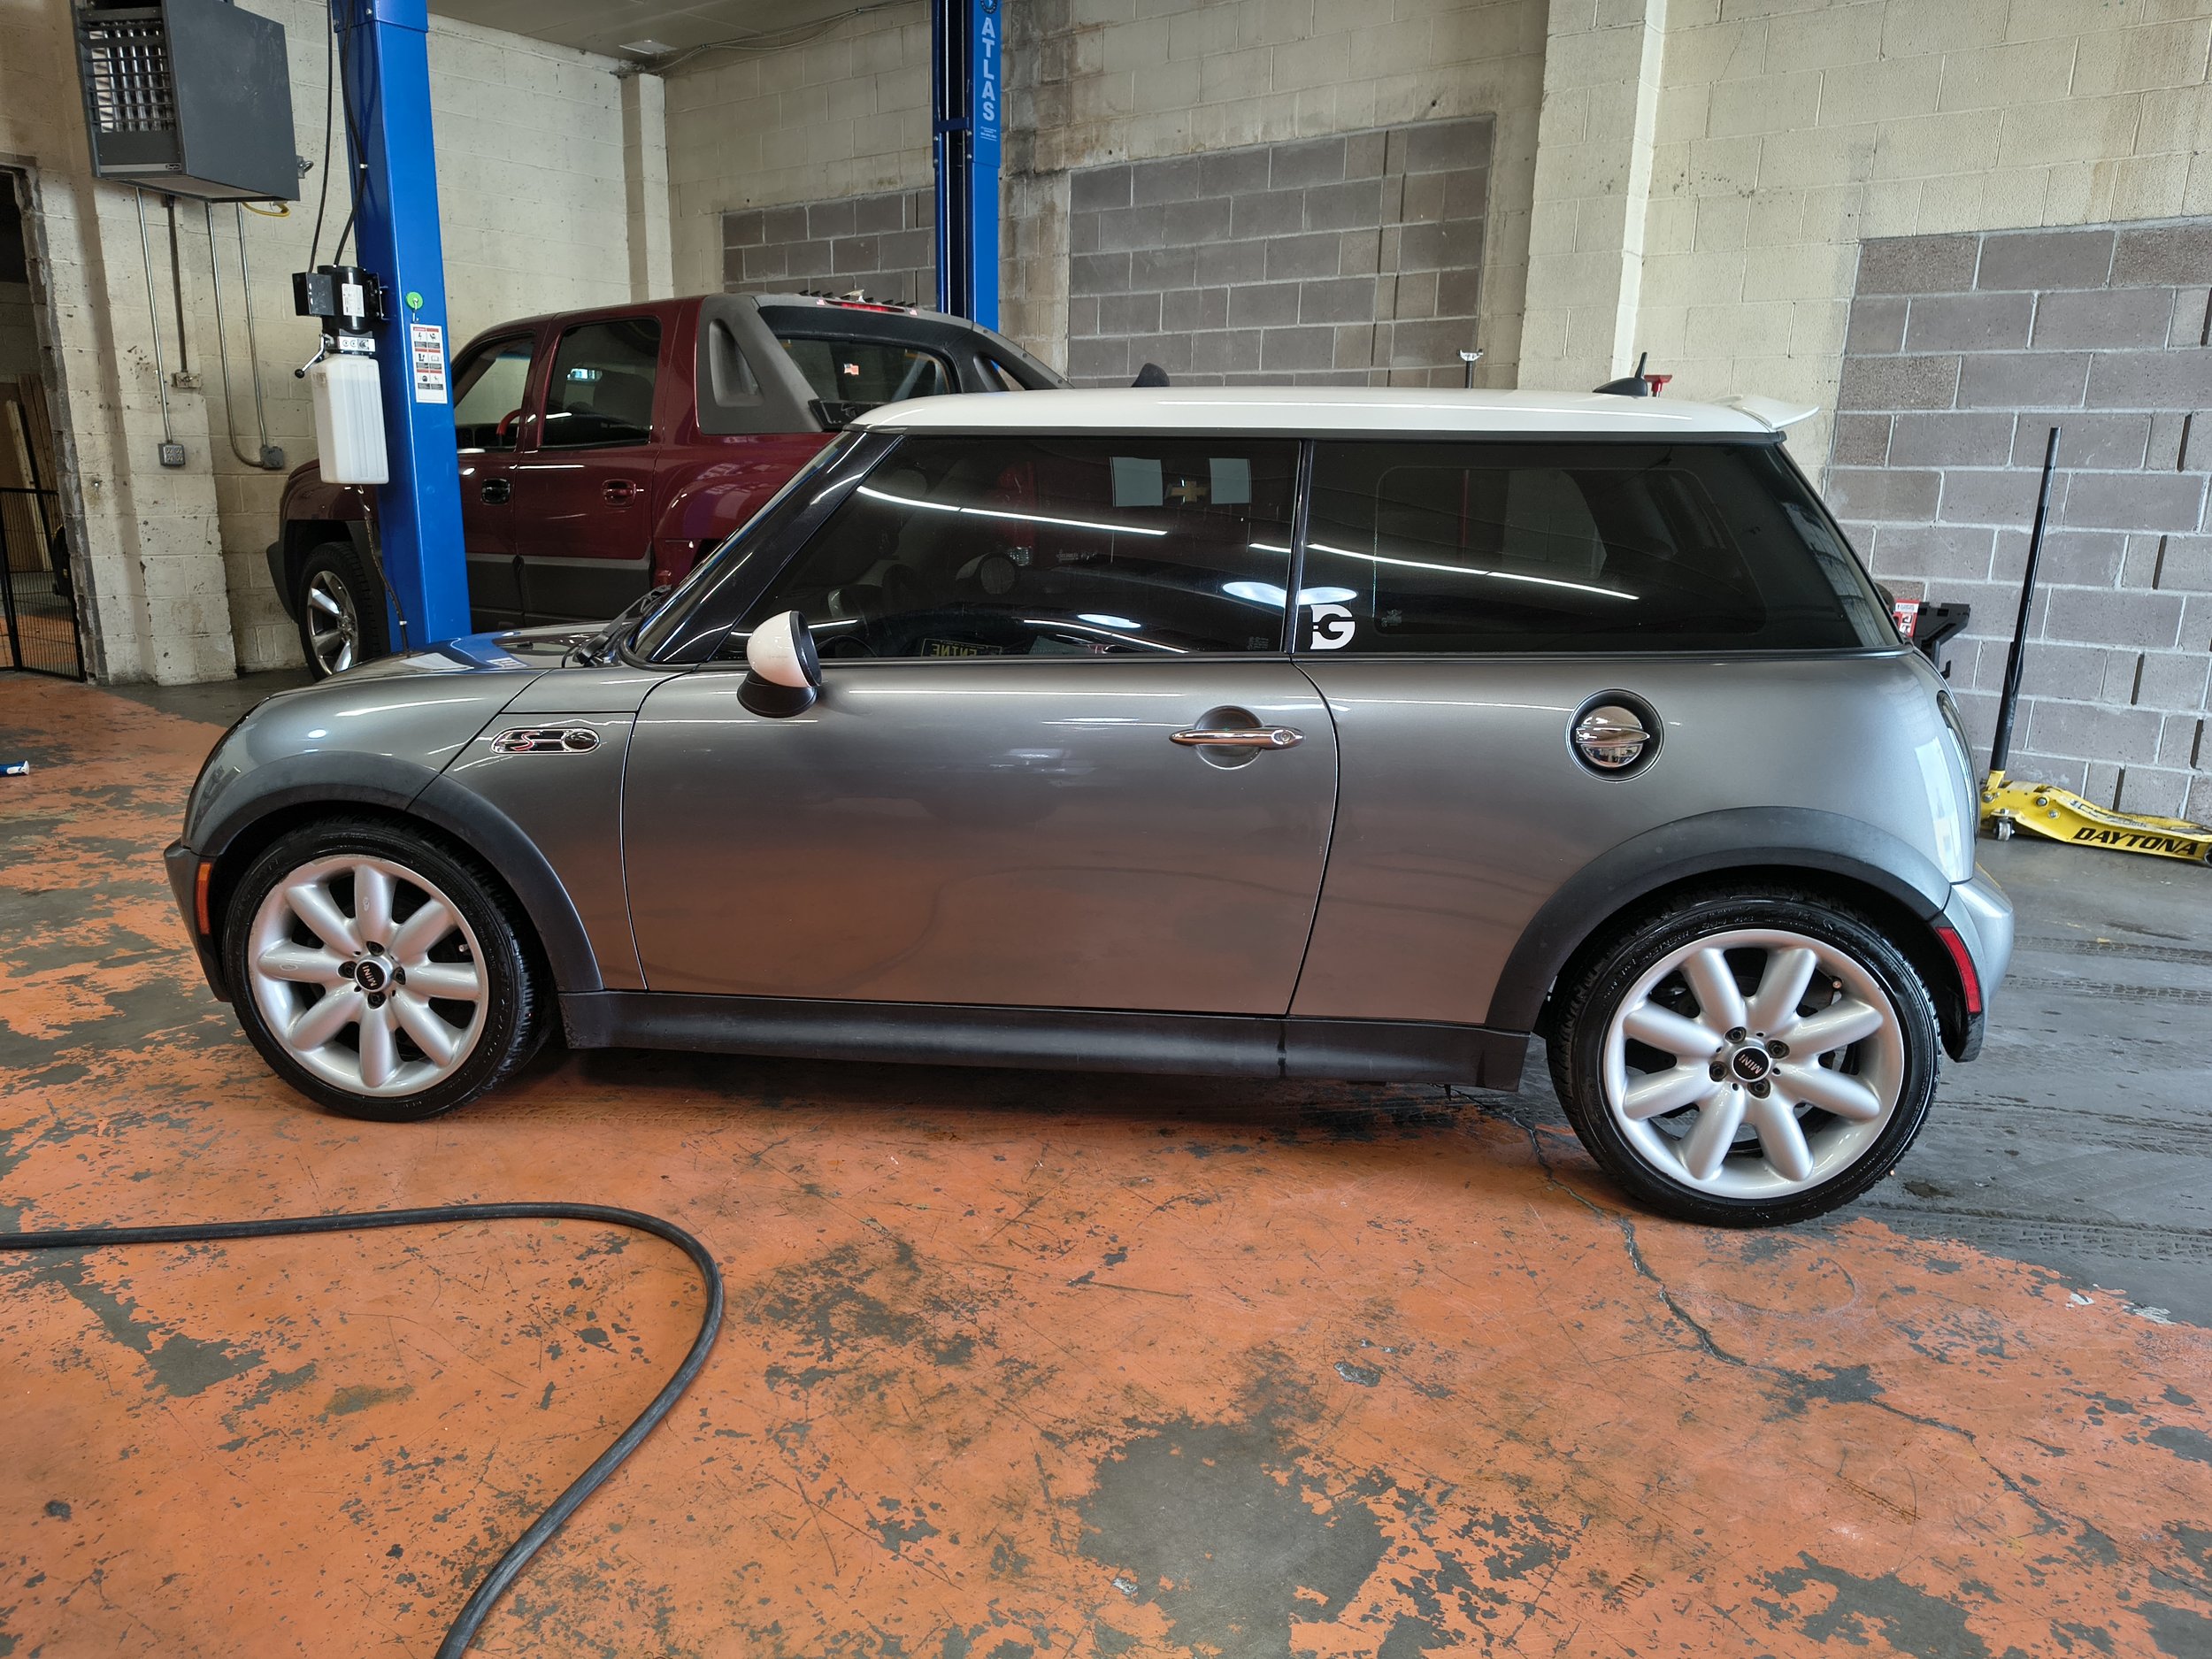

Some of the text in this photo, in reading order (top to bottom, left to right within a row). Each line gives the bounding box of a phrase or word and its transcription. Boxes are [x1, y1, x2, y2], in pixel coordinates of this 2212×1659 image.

[981, 17, 996, 121] ATLAS
[2071, 826, 2200, 856] DAYTONA
[362, 965, 378, 987] MINI
[1738, 1054, 1763, 1074] MINI
